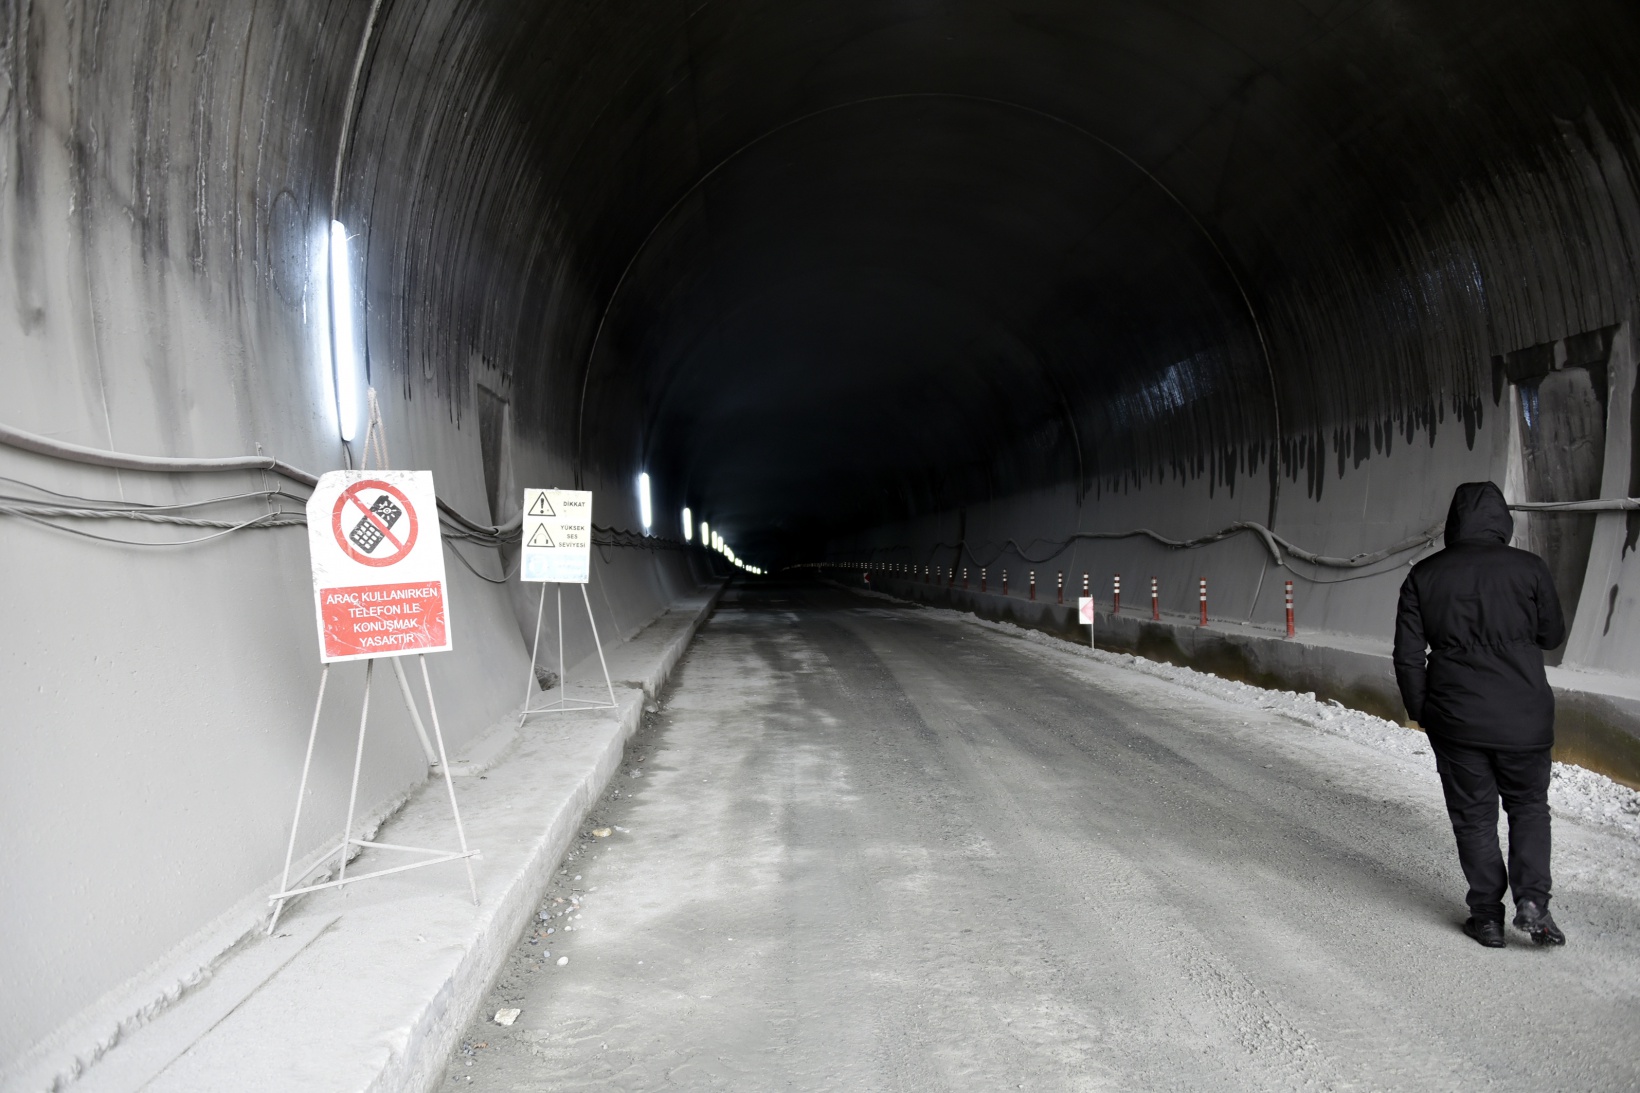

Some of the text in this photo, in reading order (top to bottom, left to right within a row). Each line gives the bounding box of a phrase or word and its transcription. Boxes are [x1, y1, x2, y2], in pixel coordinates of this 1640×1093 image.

[326, 588, 438, 604] ARAÇ KULLANIRKEN
[349, 602, 420, 618] TELEFON İLE
[353, 619, 418, 632] KONUŞMAK
[360, 634, 415, 647] YASAKTIR
